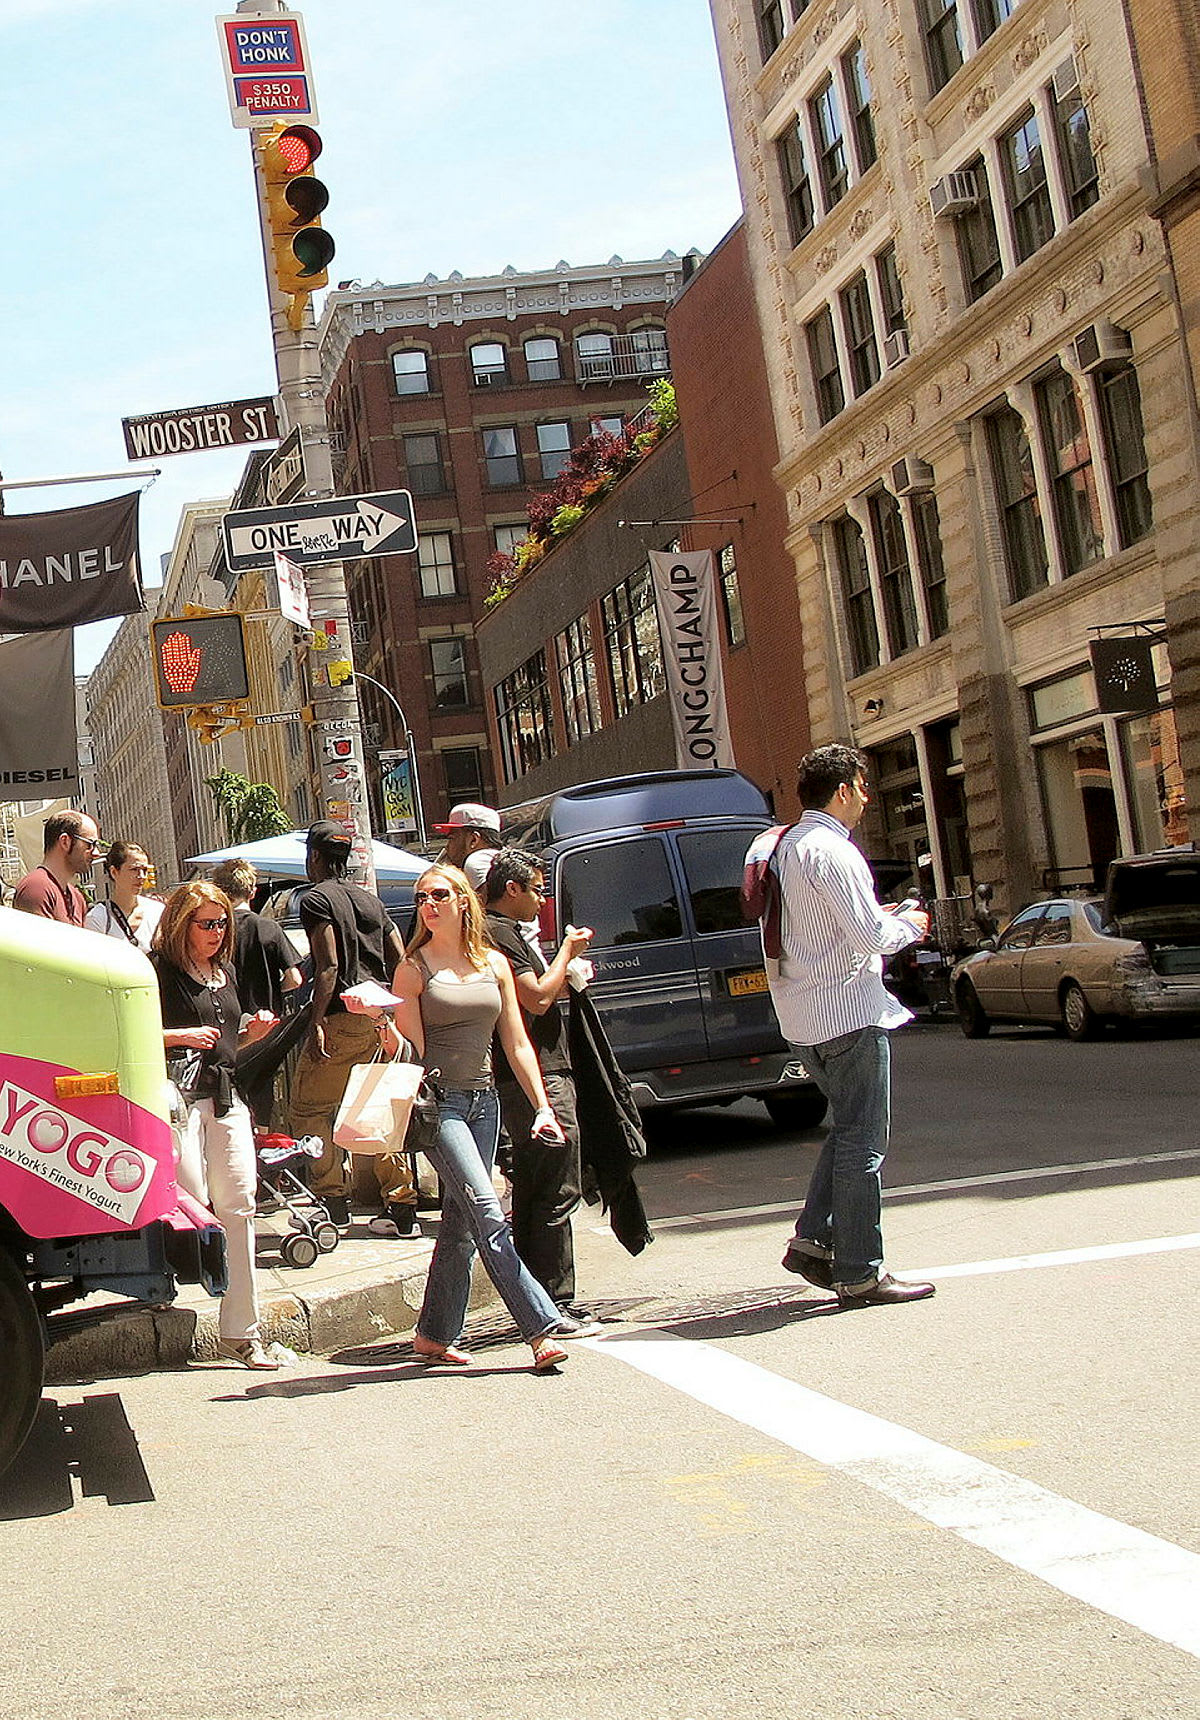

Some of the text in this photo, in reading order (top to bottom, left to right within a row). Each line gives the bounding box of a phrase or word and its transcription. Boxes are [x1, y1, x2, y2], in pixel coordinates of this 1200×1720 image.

[236, 30, 288, 46] DON'T
[241, 46, 291, 62] HONK
[245, 95, 300, 108] PENALTY
[129, 413, 234, 457] WOOSTER
[242, 406, 269, 441] ST
[251, 523, 299, 550] ONE
[332, 513, 384, 541] WAY
[670, 564, 718, 769] ONGCHAMP
[385, 776, 408, 791] NYC
[1, 1090, 145, 1193] YOGO
[17, 1150, 48, 1175] York's
[48, 1168, 83, 1193] Finest
[86, 1185, 122, 1213] Yogurt
